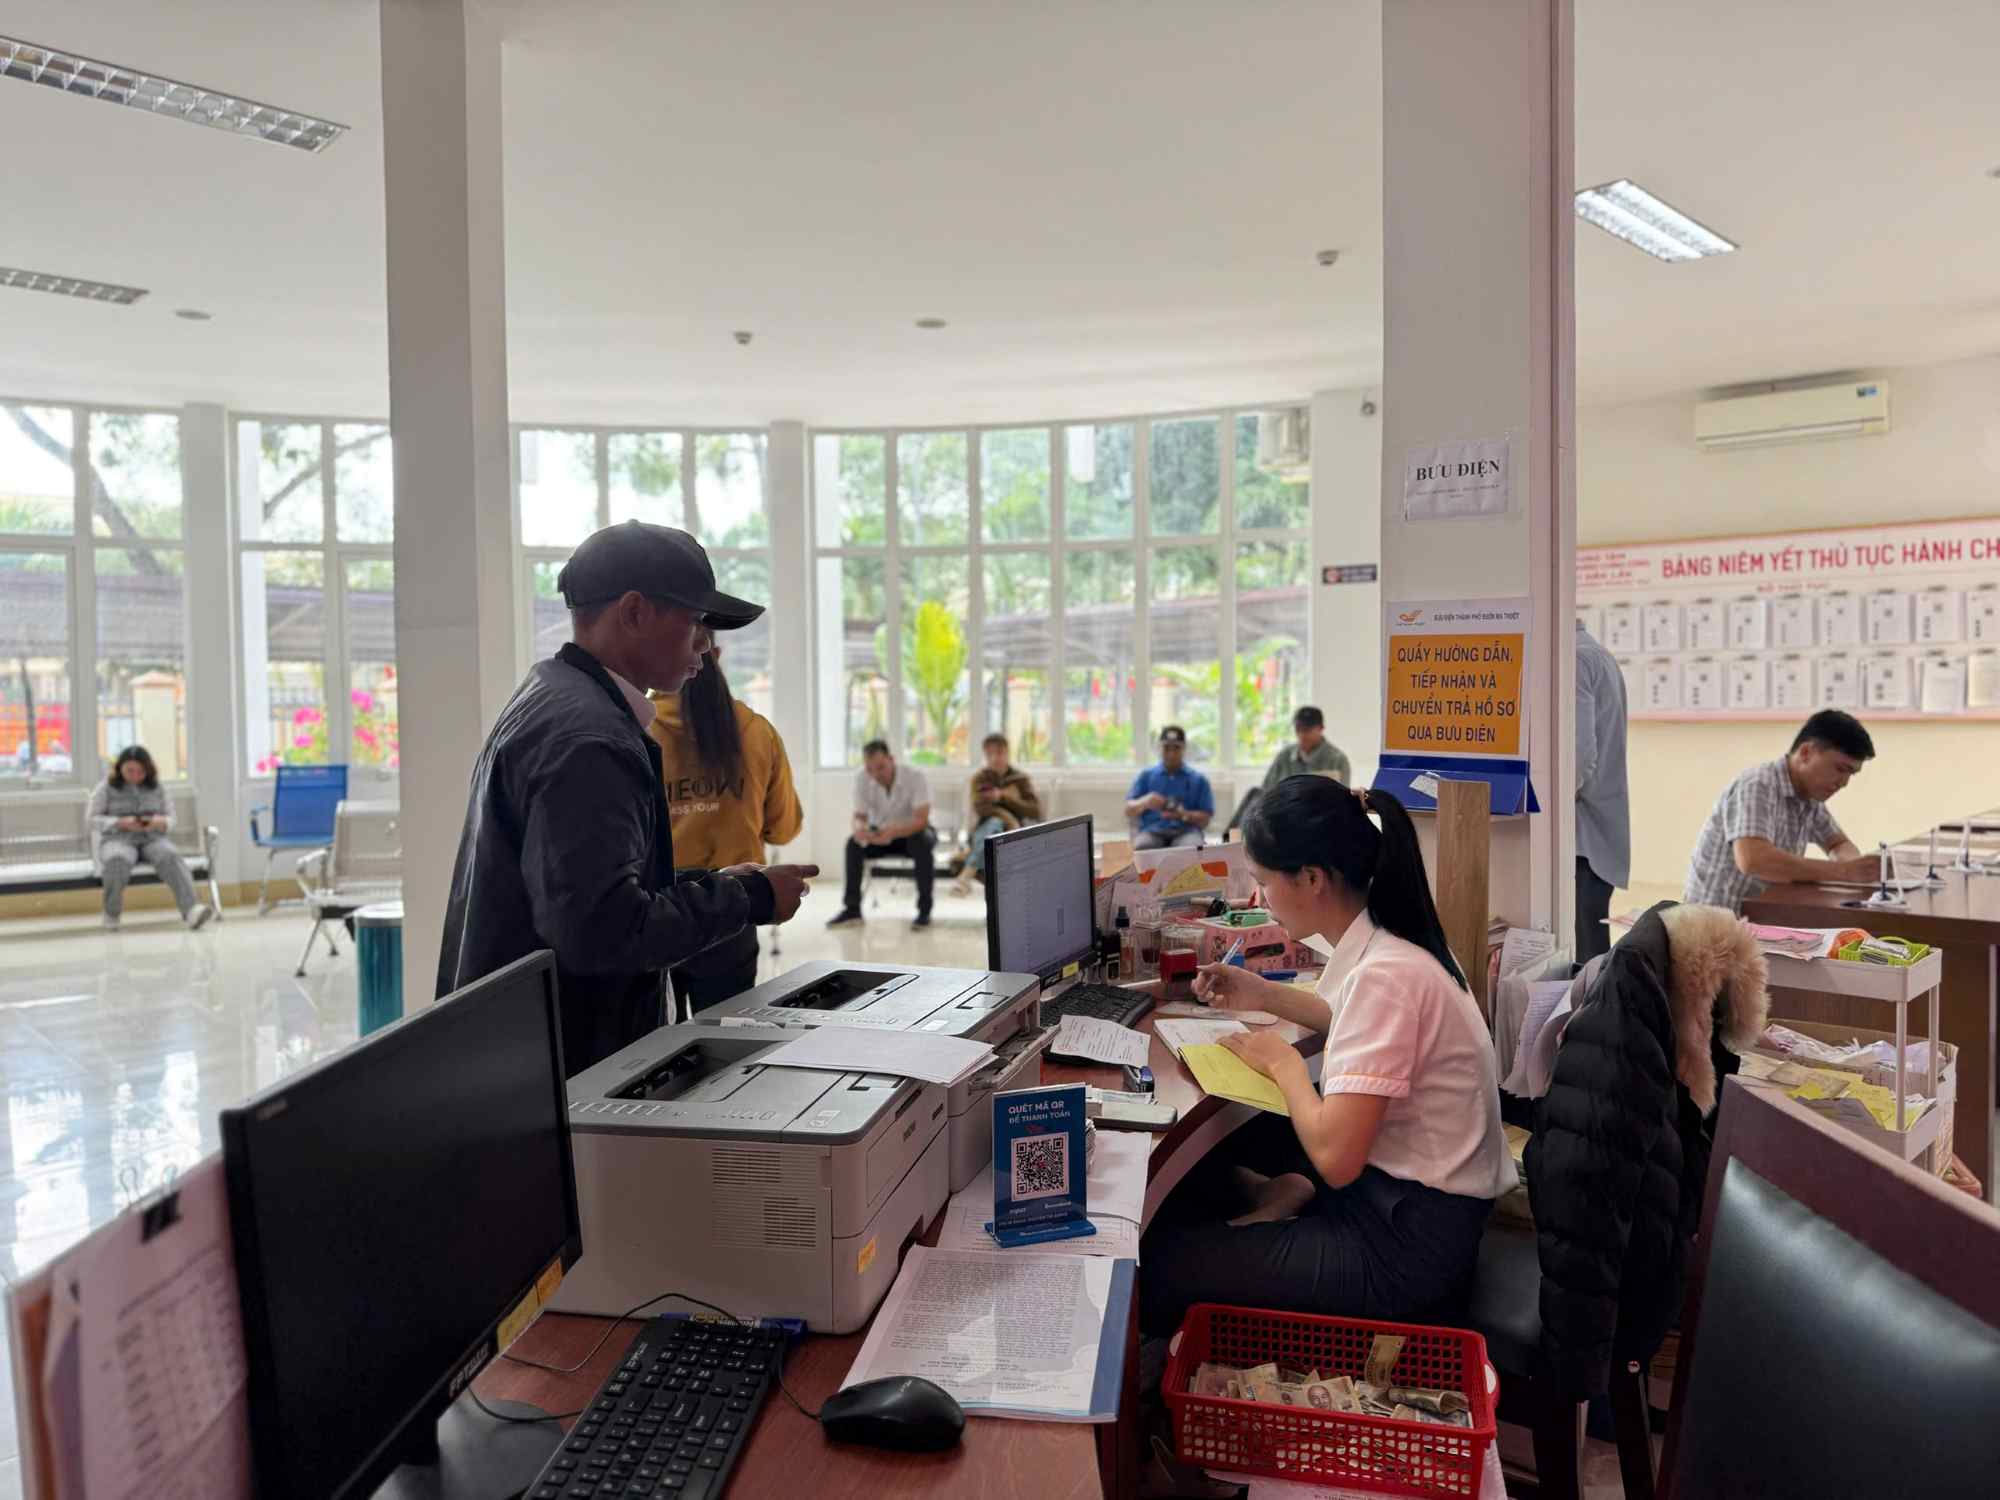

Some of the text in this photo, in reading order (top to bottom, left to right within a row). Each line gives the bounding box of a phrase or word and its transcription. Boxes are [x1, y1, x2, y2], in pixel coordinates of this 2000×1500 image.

[1662, 553, 1713, 578] BẢNG
[1718, 549, 1765, 576] NIÊM
[1769, 541, 1803, 572] YẾT
[1809, 541, 1849, 569] THỦ
[1854, 543, 1895, 572] TỤC
[1902, 537, 1963, 564] HÀNH
[1434, 643, 1479, 662] HƯỚNG
[1410, 668, 1497, 692] TIẾP NHẬN VÀ
[1392, 692, 1442, 715] CHUYỂN
[1446, 695, 1471, 715] TRẢ
[1497, 699, 1516, 716] SƠ
[1407, 723, 1496, 744] QUA BƯU ĐIỆN
[1008, 1103, 1033, 1115] QUÉT
[1050, 1100, 1065, 1110] QR
